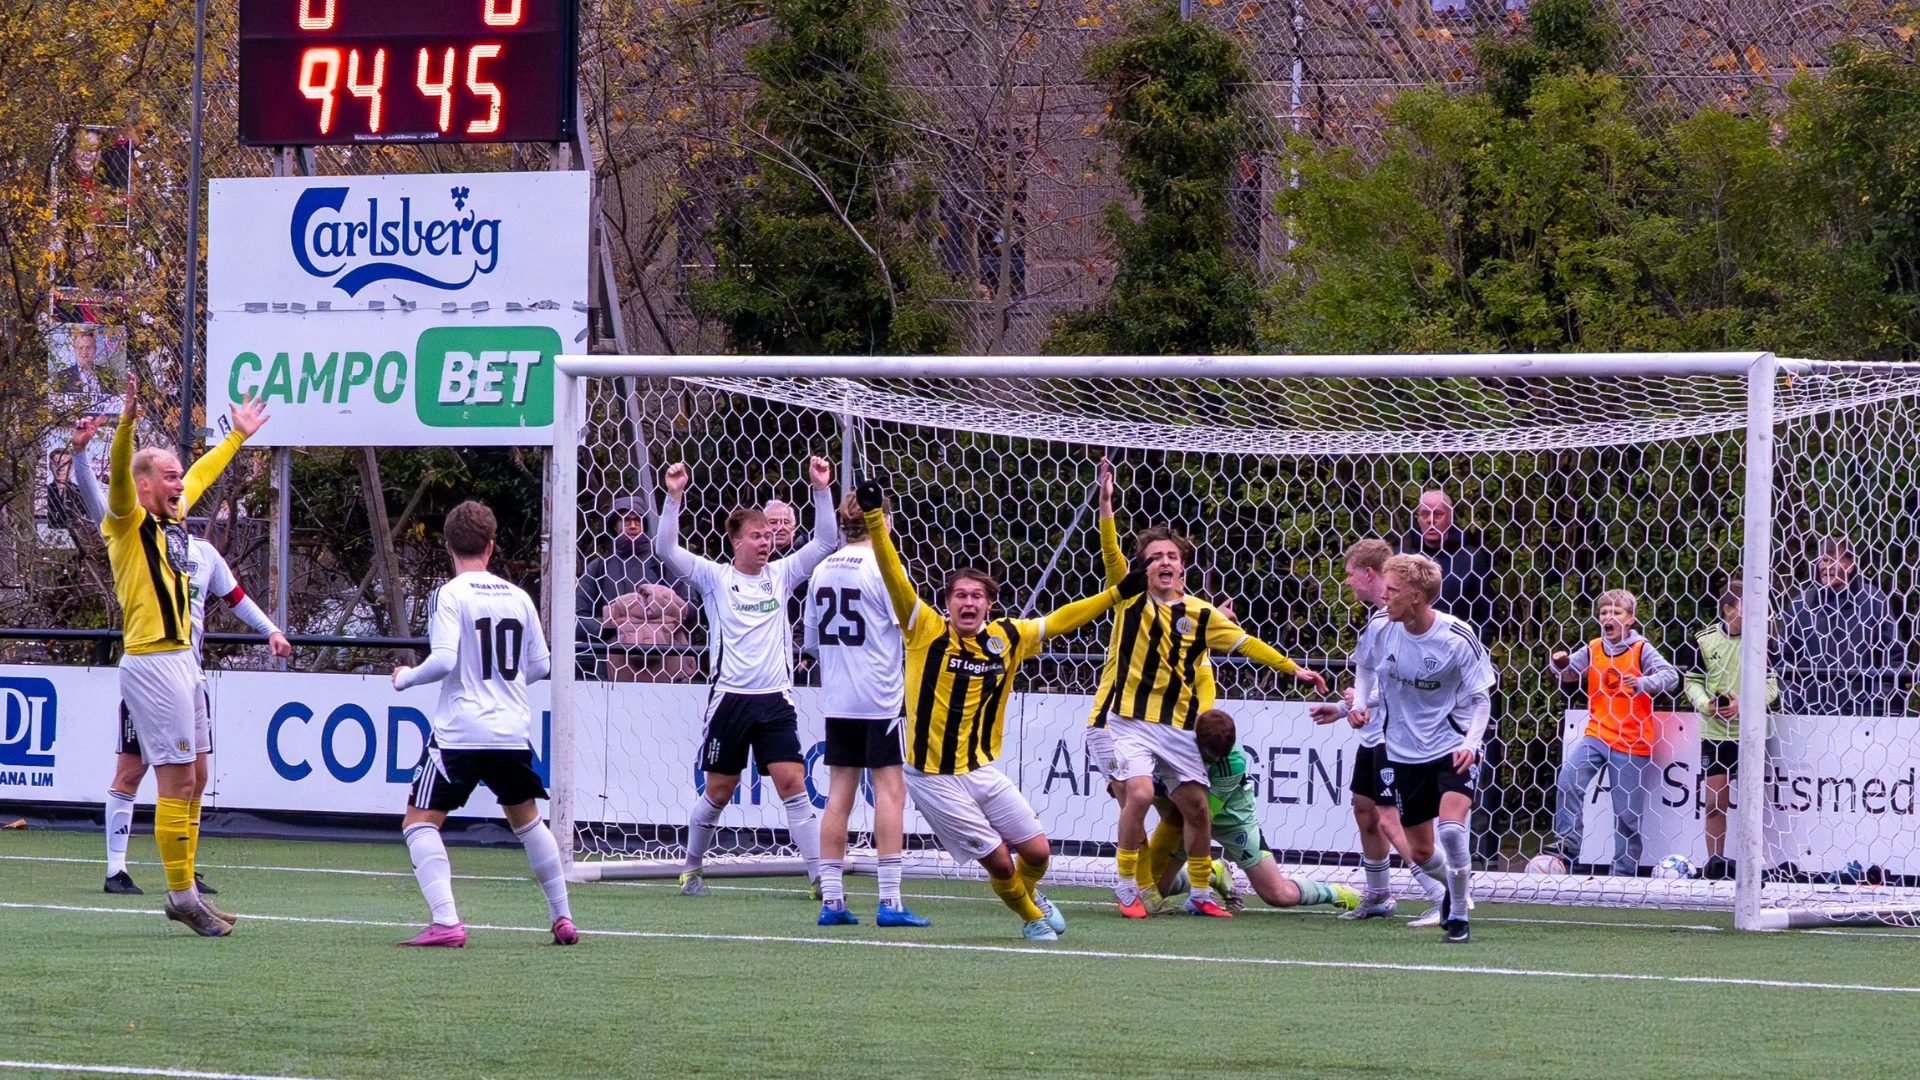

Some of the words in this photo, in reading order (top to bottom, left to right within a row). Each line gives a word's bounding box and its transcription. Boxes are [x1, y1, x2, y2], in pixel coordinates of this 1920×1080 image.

[300, 47, 385, 134] 94
[416, 45, 502, 133] 45
[291, 187, 502, 278] Carlsberg
[228, 351, 408, 404] CAMPO
[437, 351, 541, 405] BET
[816, 587, 866, 646] 25
[475, 617, 524, 681] 10
[949, 658, 963, 669] ST
[31, 772, 54, 787] LIM
